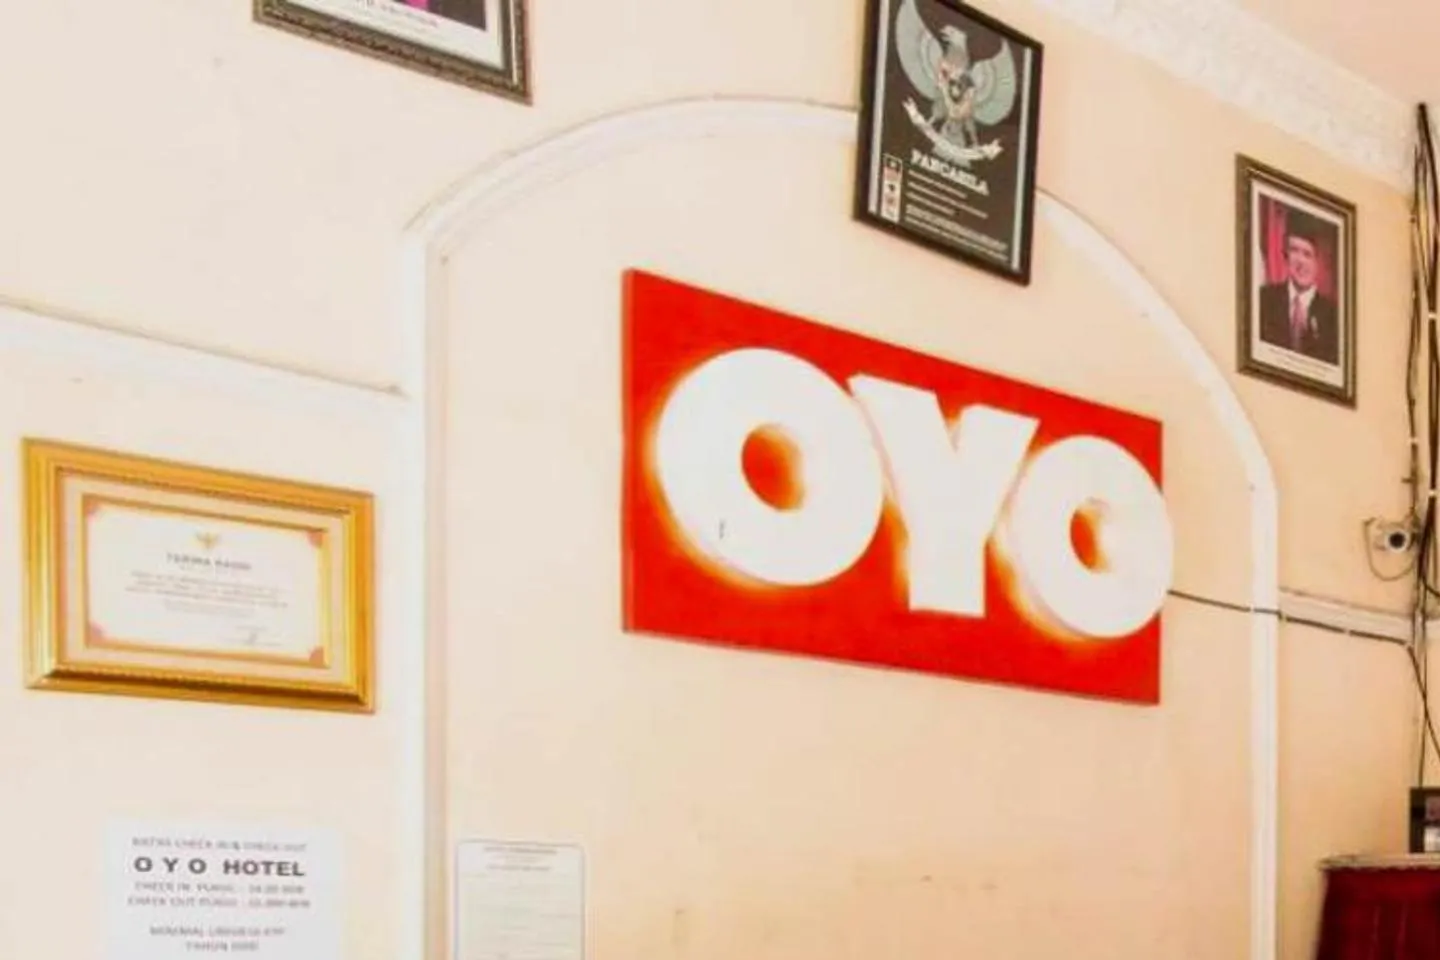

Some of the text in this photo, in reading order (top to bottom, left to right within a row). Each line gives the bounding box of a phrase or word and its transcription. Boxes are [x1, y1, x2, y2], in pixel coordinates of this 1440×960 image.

[911, 149, 989, 196] PANCASILA
[655, 347, 1173, 640] OYO
[223, 859, 305, 876] HOTEL
